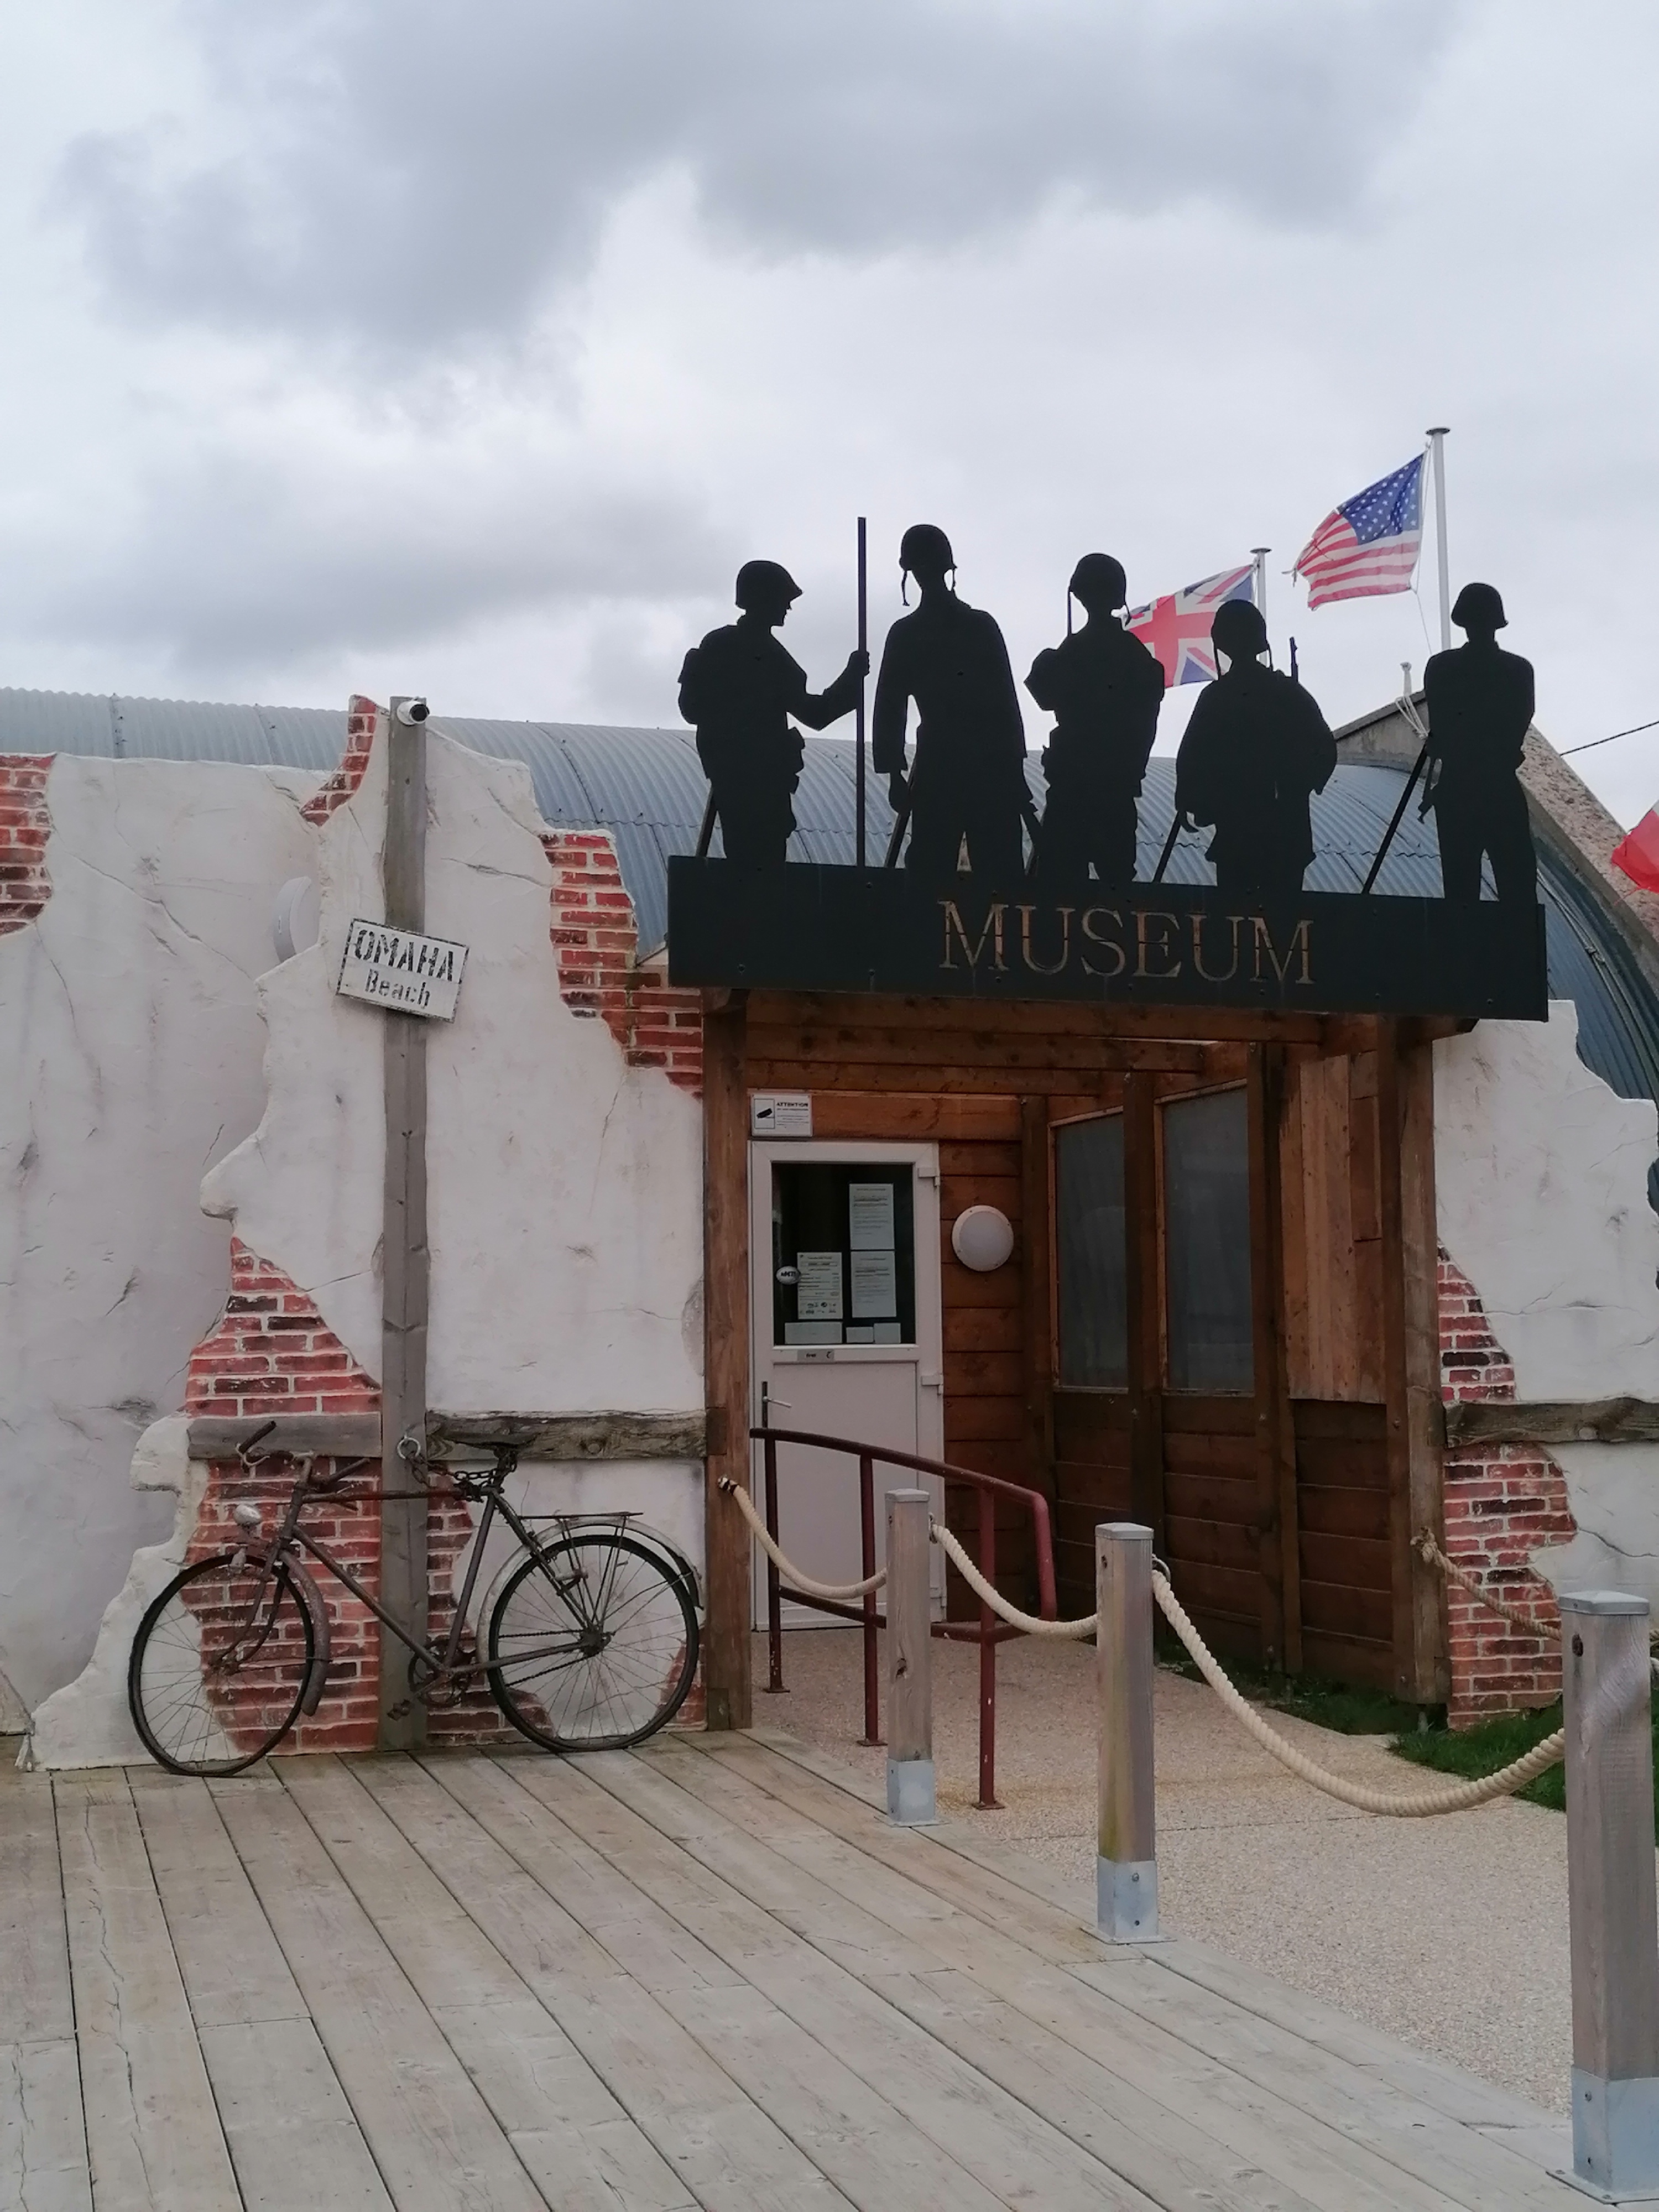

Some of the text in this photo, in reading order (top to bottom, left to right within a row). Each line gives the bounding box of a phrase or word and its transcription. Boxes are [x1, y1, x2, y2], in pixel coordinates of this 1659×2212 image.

[354, 929, 453, 982] OMAHA
[938, 899, 1315, 985] MUSEUM
[364, 968, 431, 1008] Beach
